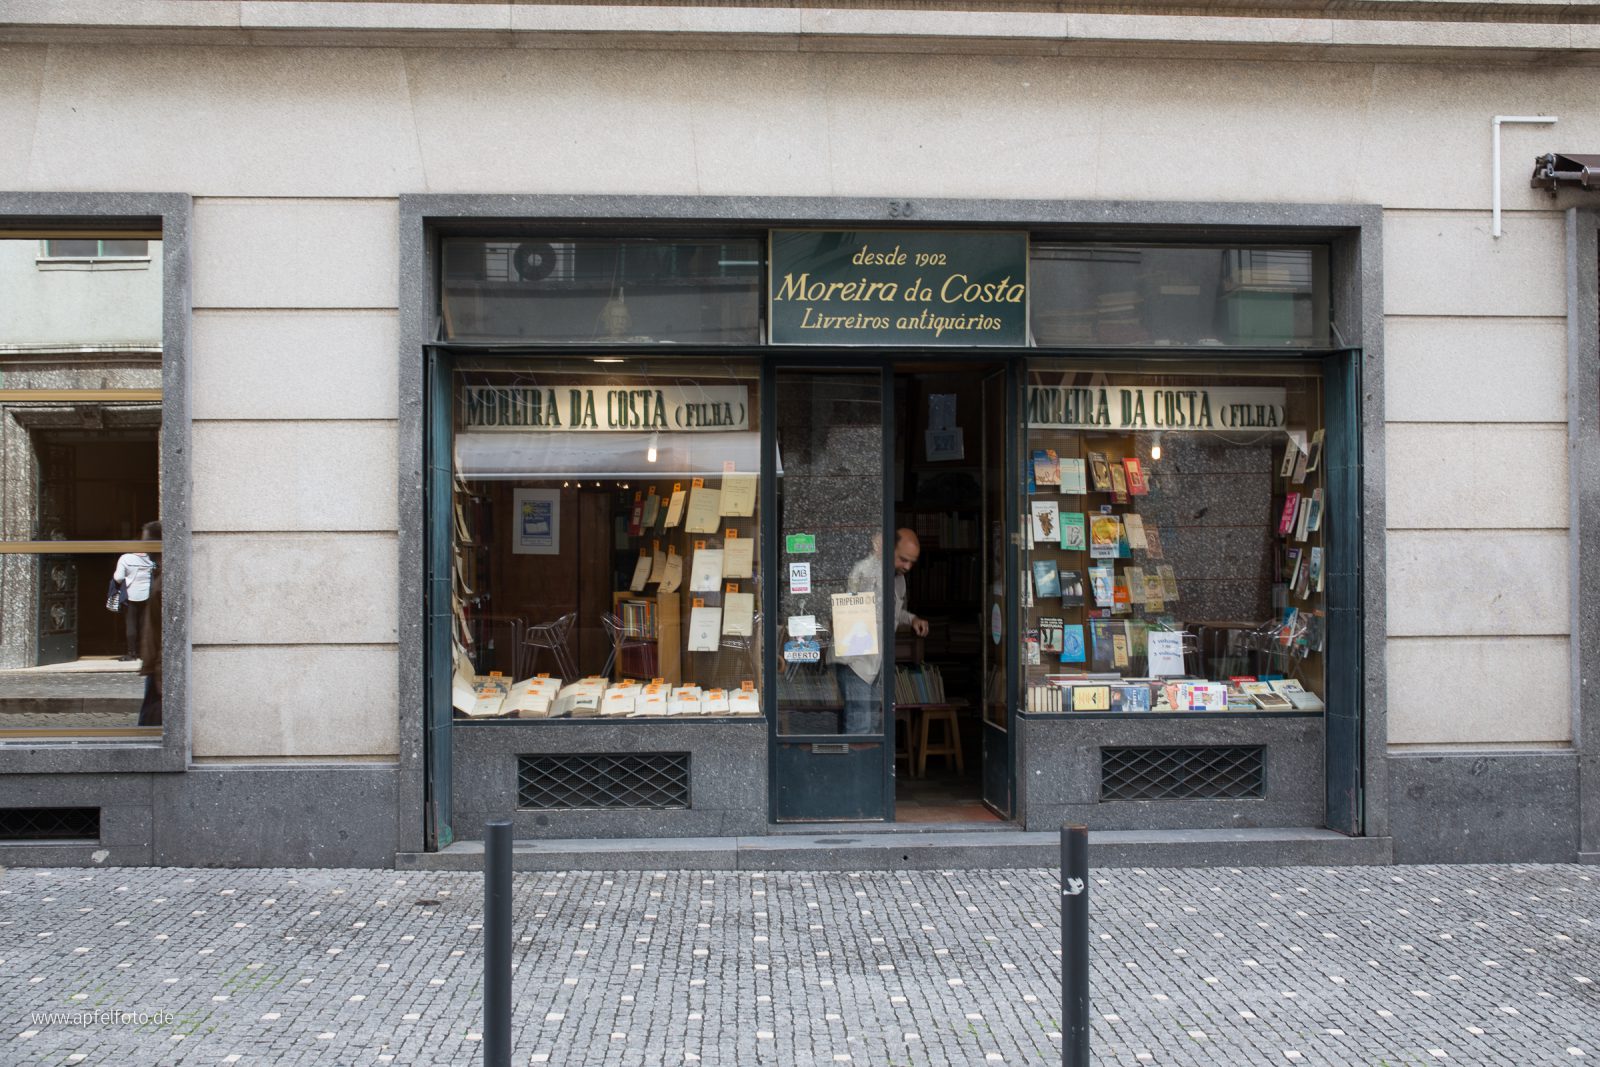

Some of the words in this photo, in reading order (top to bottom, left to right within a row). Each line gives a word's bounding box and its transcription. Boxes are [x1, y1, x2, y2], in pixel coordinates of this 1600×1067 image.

[851, 245, 907, 266] desde
[914, 253, 947, 266] 1902
[774, 273, 898, 302] Moreira
[903, 277, 933, 302] da
[941, 274, 1025, 303] Costa
[800, 308, 890, 330] Livreiros
[895, 308, 1002, 338] antiquários
[466, 388, 562, 427] MOREIRA
[569, 389, 599, 429] DA
[607, 389, 669, 429] COSTA
[1120, 389, 1147, 427] DA
[1153, 390, 1213, 428] COSTA
